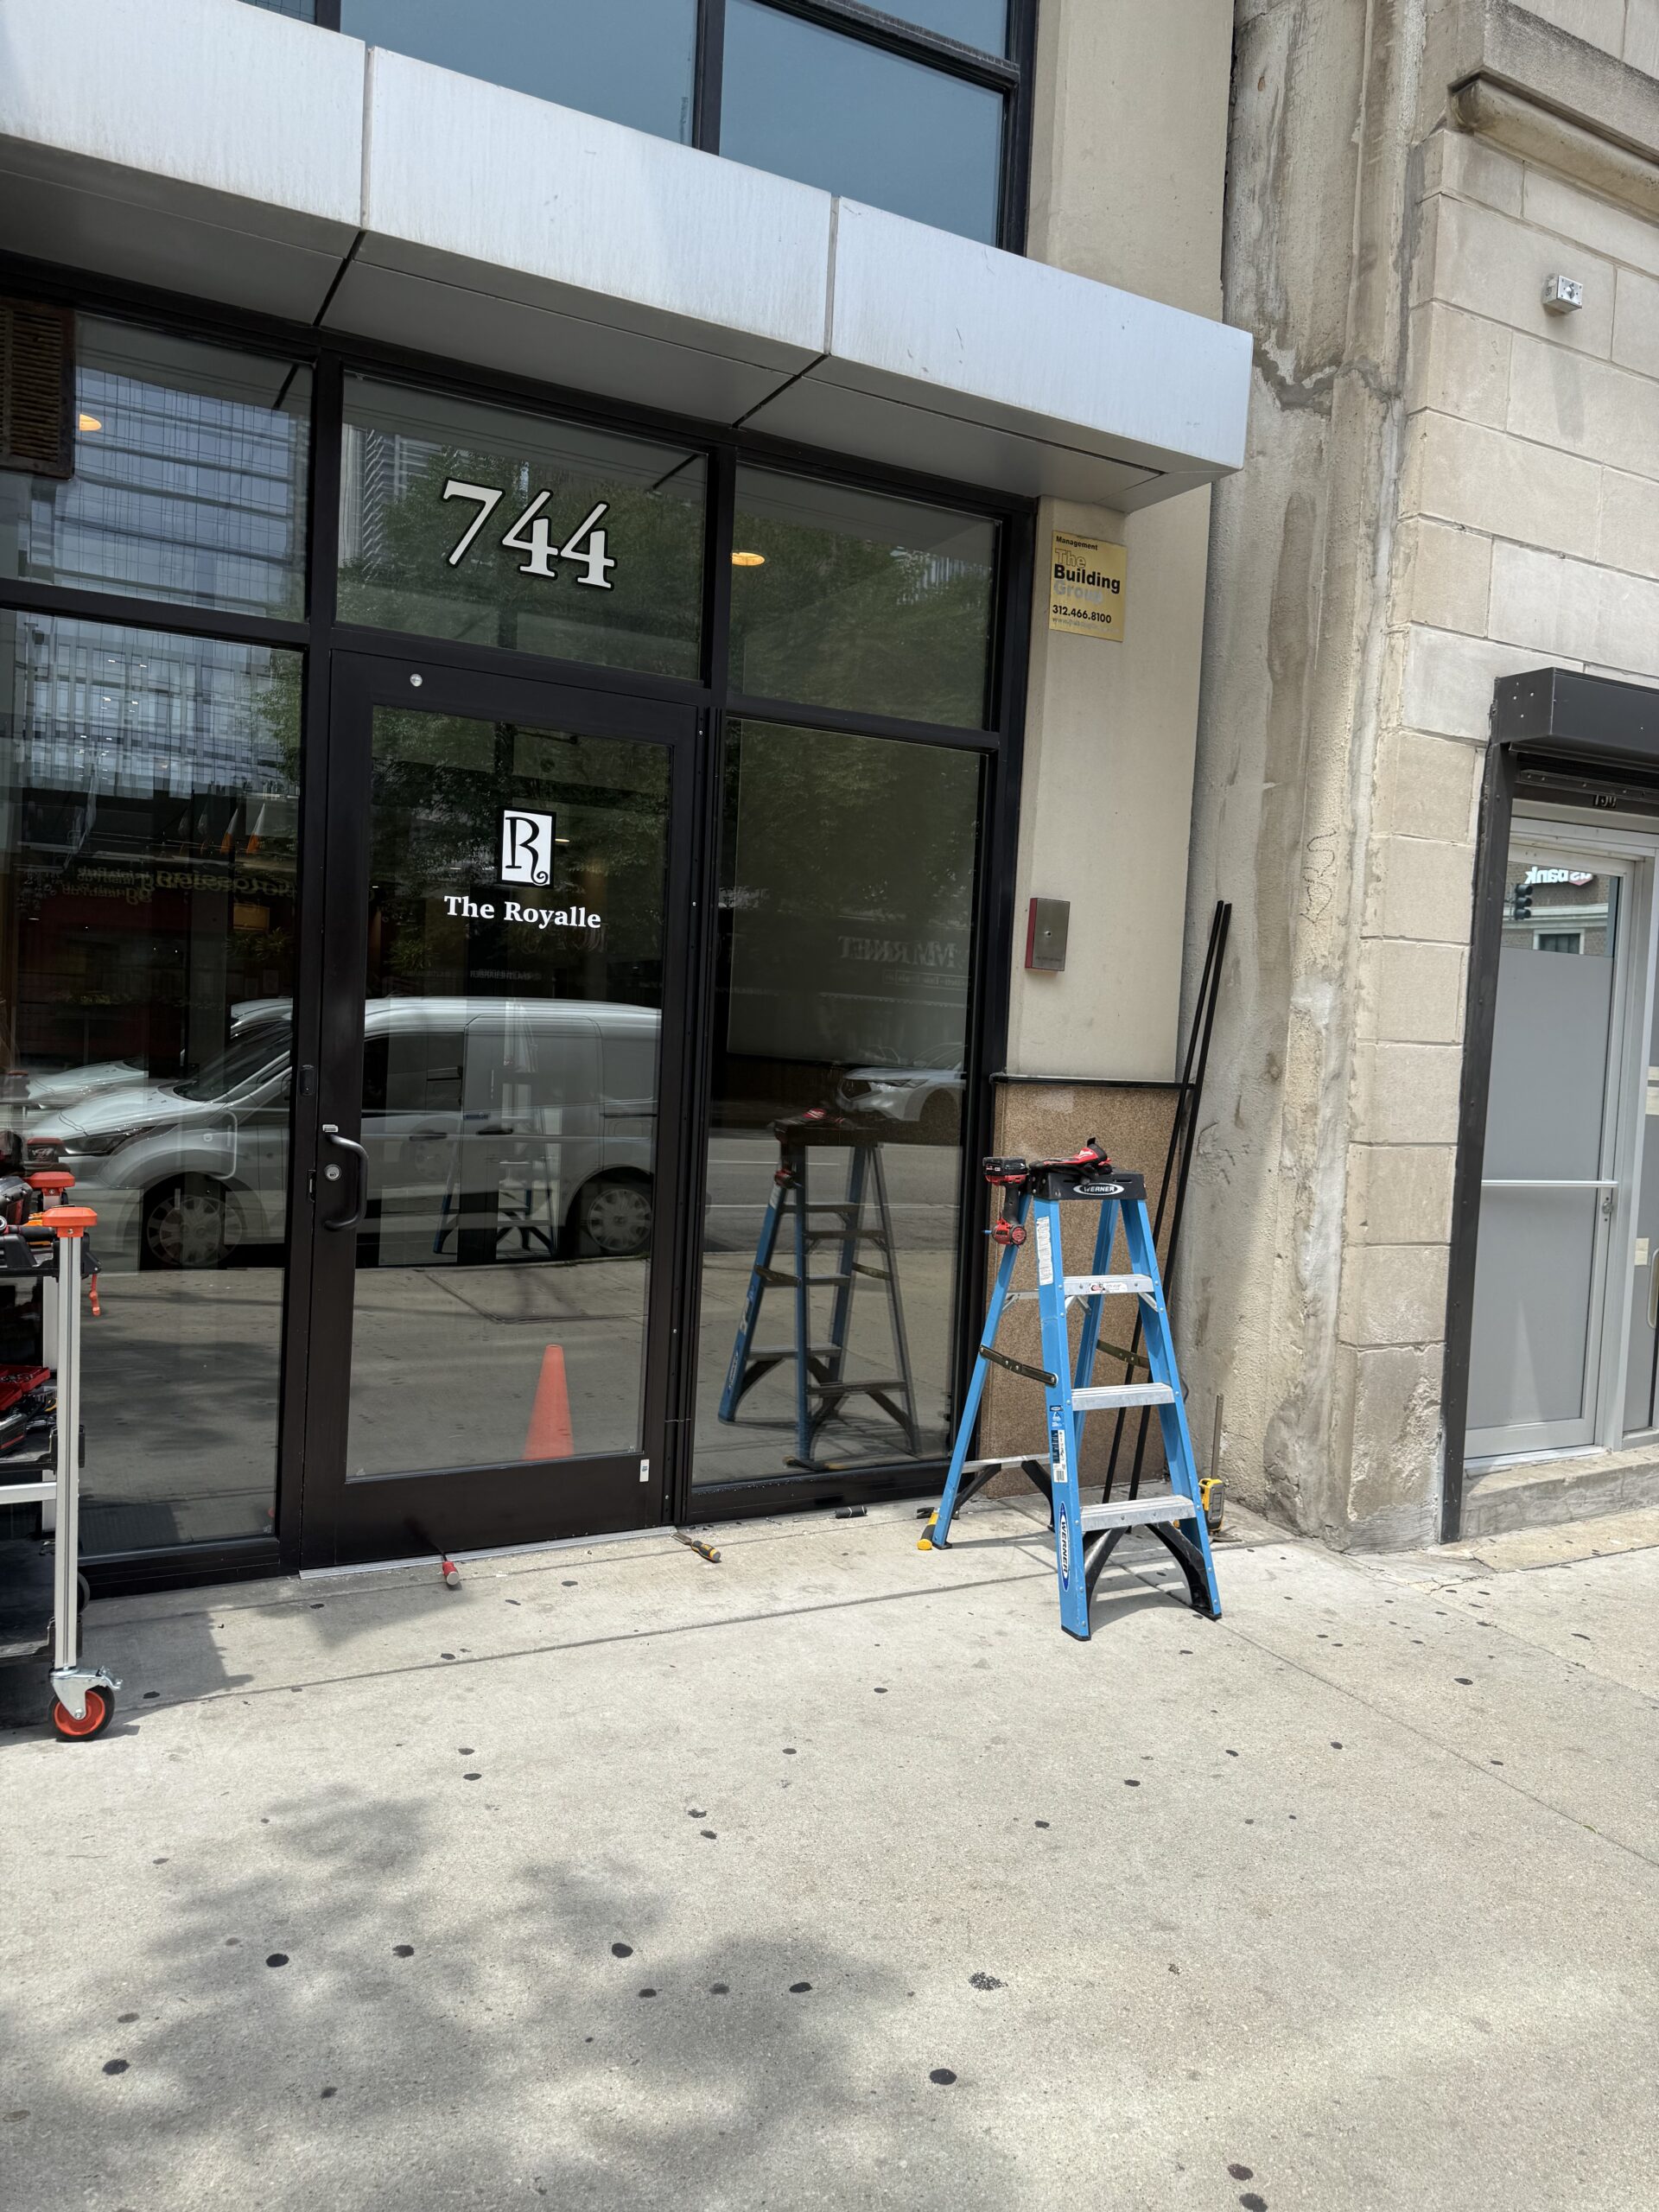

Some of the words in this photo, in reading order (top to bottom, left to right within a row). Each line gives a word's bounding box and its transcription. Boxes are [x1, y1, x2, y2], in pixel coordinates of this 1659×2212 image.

[442, 477, 617, 590] 744
[1056, 535, 1098, 550] Management
[1054, 548, 1086, 569] The
[1054, 563, 1121, 594] Building
[1052, 605, 1112, 624] 312.466.8100
[505, 817, 549, 886] R
[444, 895, 495, 919] The
[504, 901, 601, 930] Royalle
